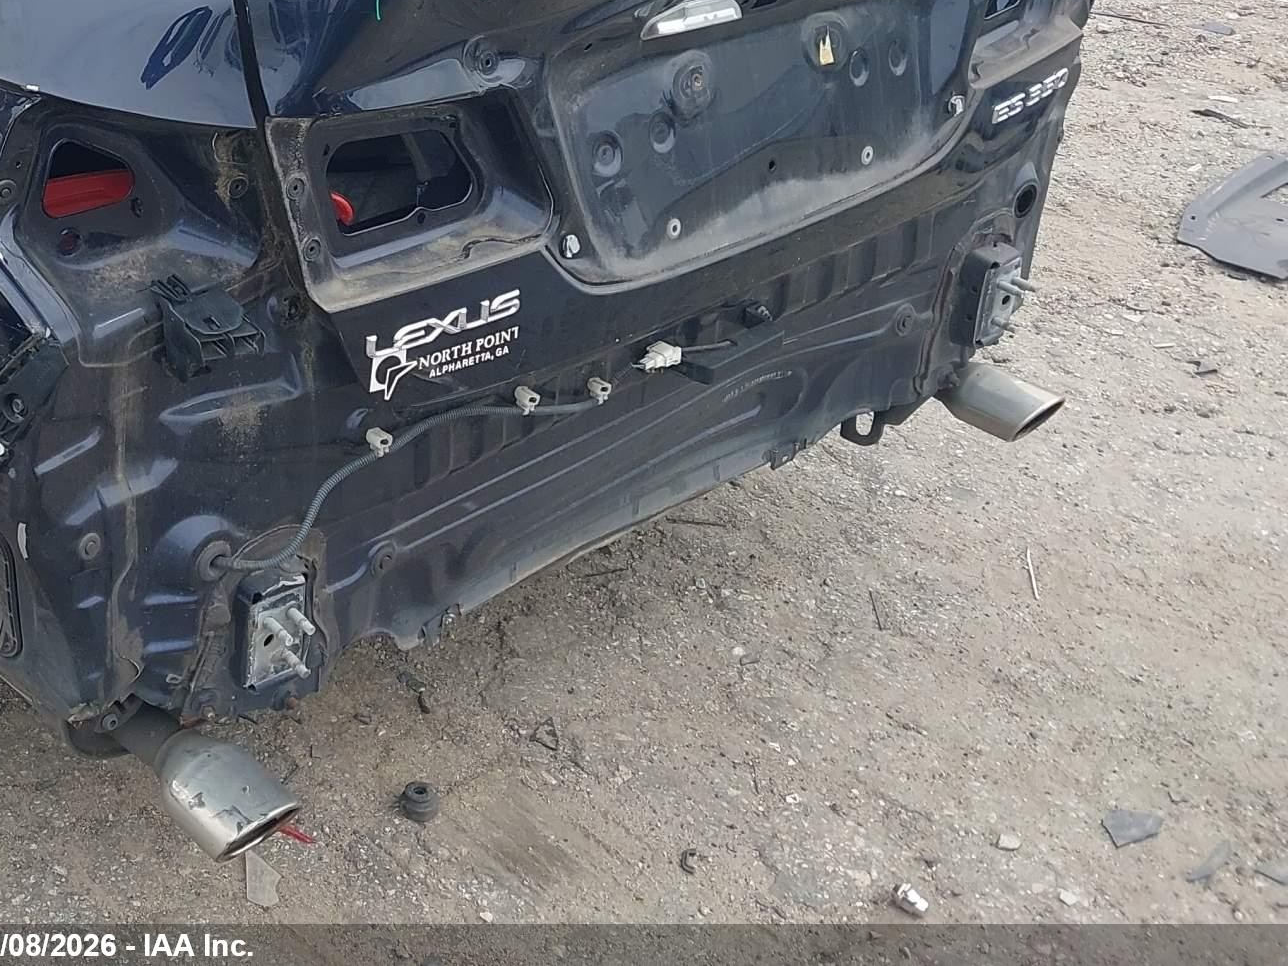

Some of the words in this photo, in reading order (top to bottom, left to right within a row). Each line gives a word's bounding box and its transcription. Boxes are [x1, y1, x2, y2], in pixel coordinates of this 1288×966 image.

[992, 92, 1026, 124] ES
[1025, 67, 1069, 107] 350
[366, 289, 520, 358] LEXUS
[418, 340, 473, 370] NORTH
[475, 326, 520, 352] POINT
[429, 351, 495, 379] ALPHARETTA,
[495, 345, 510, 358] GA
